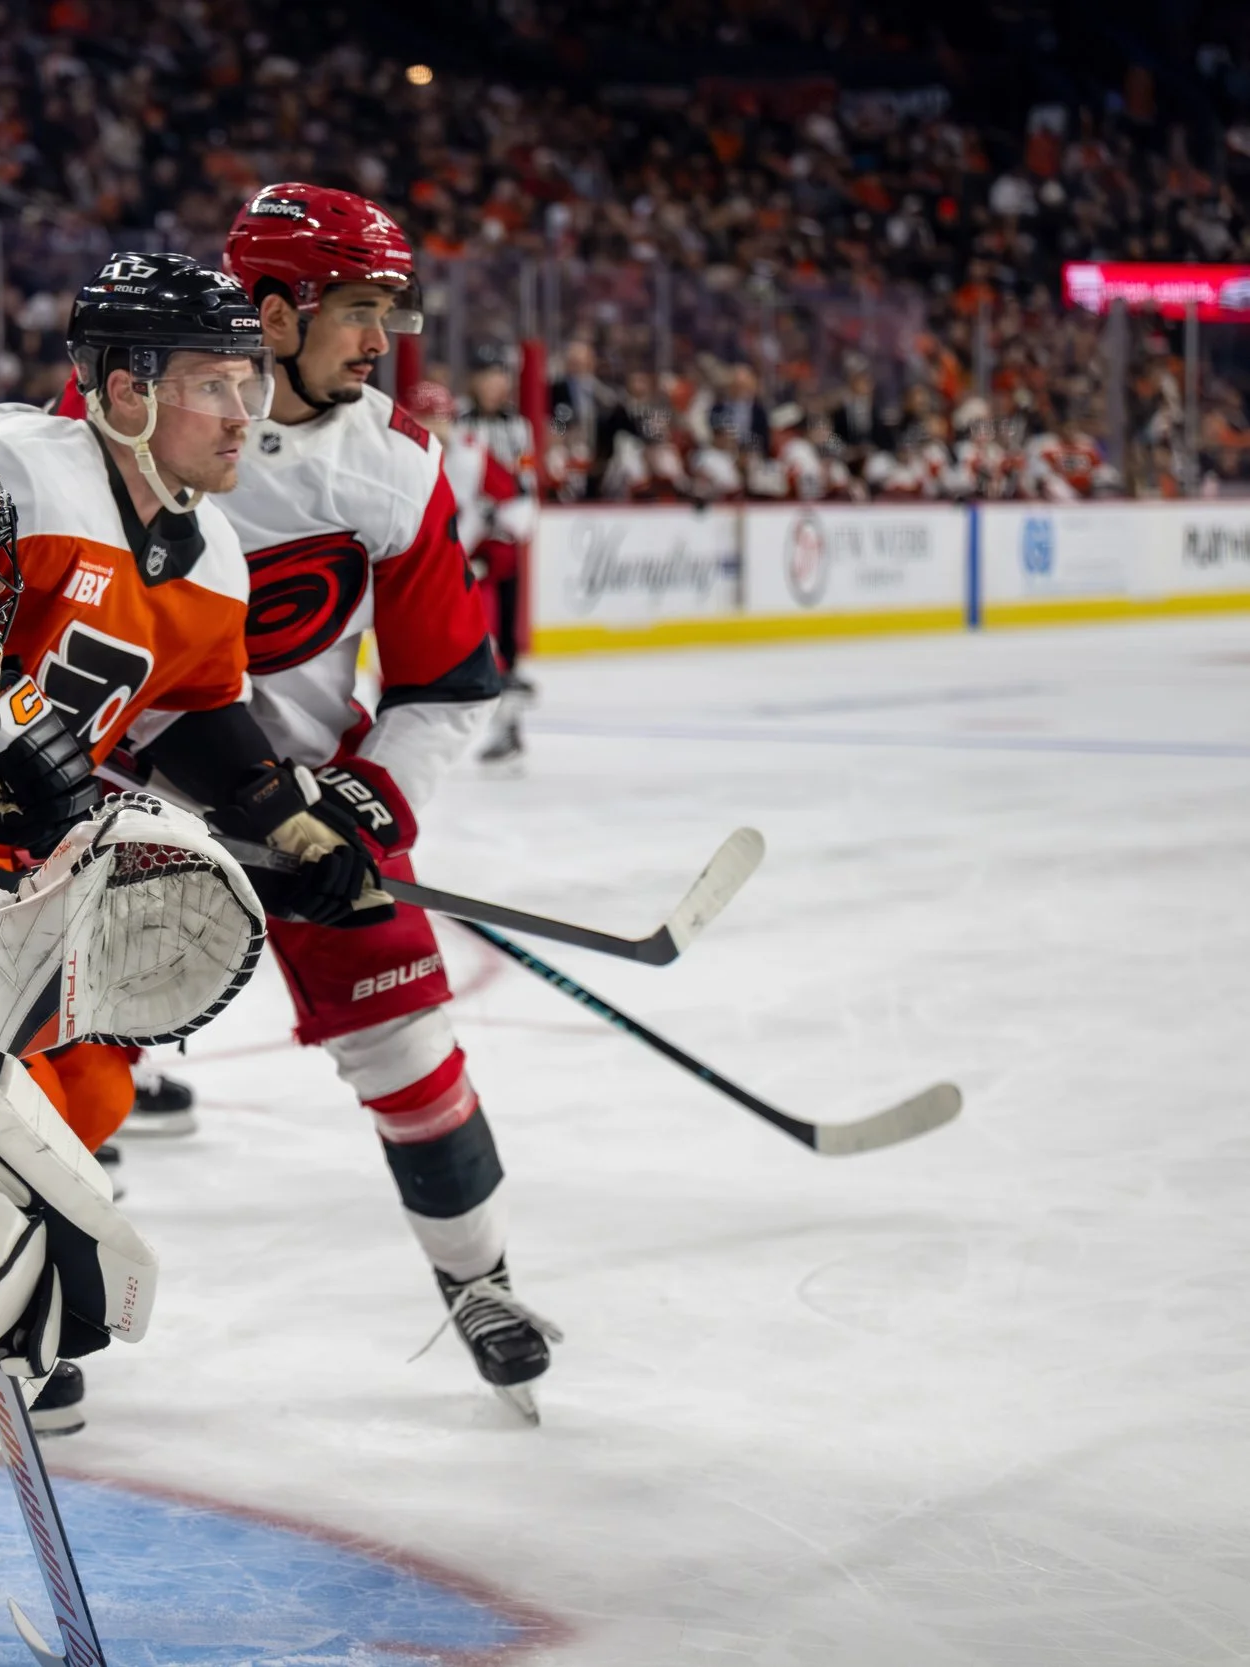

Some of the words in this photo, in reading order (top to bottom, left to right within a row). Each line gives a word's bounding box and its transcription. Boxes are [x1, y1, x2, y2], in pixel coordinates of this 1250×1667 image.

[63, 569, 111, 607] IBX
[318, 767, 394, 831] UER
[65, 949, 78, 1039] TRUE
